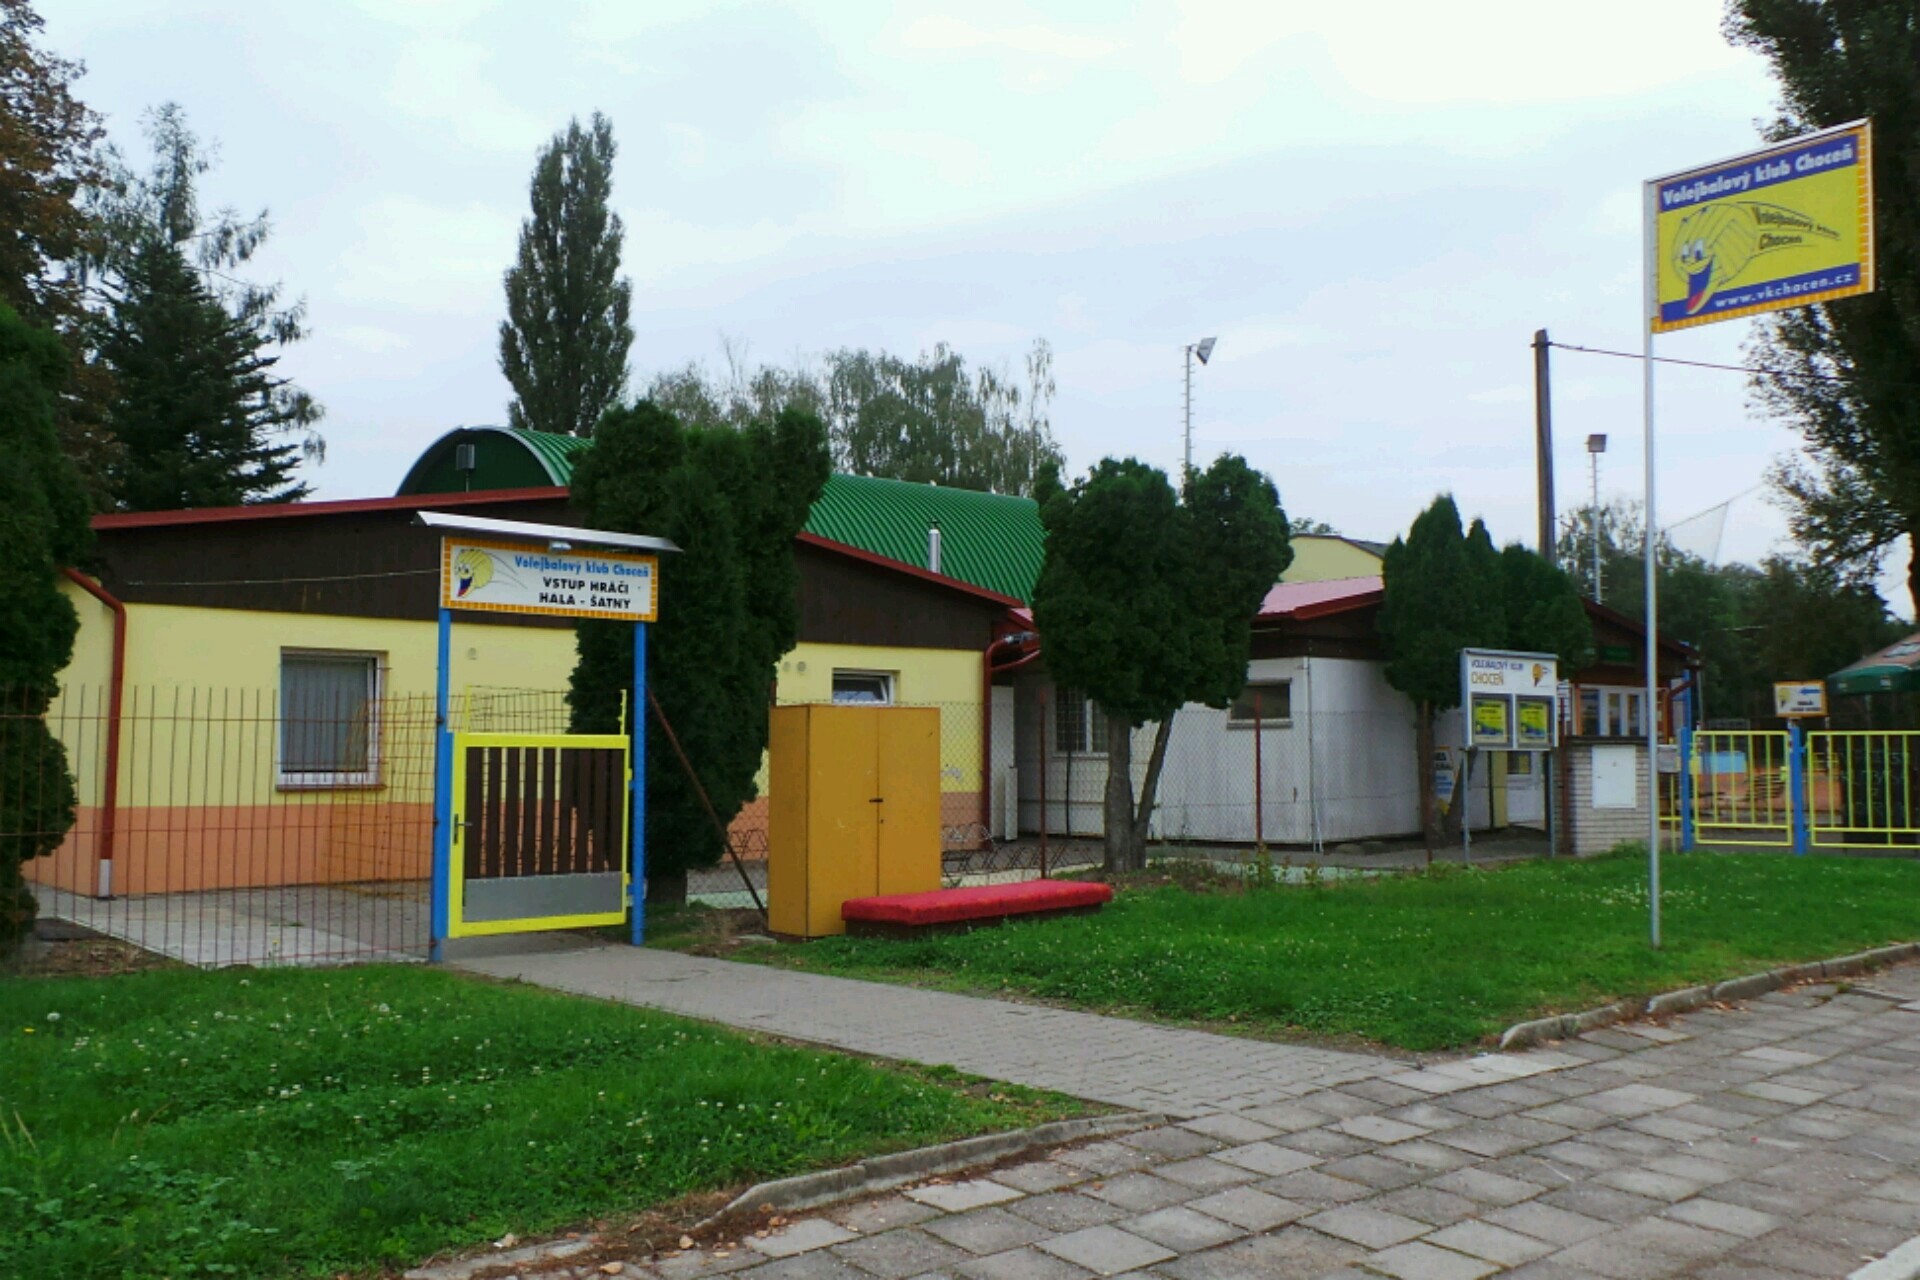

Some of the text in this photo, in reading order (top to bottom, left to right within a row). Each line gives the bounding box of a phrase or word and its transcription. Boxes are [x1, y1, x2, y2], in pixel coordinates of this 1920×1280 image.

[1663, 144, 1853, 205] Volejbalový klub Choceň
[1714, 272, 1854, 308] www.vkchocen.cz
[515, 555, 648, 577] Volejbalový klub Choceň
[543, 577, 585, 590] VSTUP
[539, 592, 575, 605] HALA
[590, 596, 631, 609] ŠATNY
